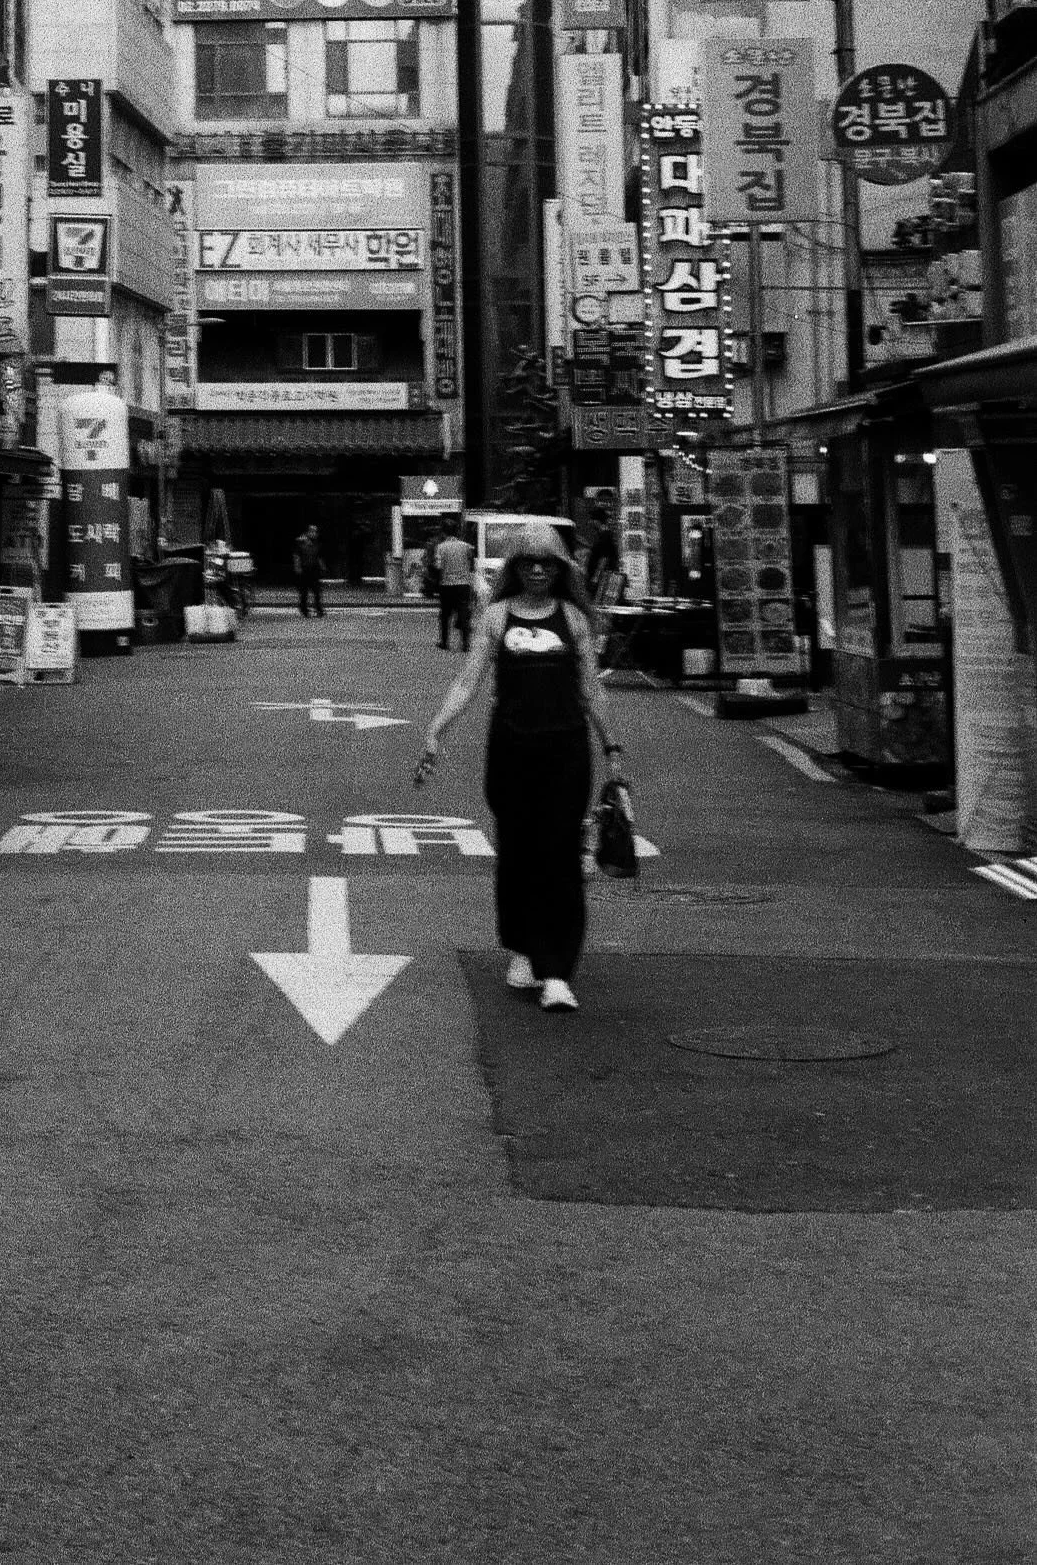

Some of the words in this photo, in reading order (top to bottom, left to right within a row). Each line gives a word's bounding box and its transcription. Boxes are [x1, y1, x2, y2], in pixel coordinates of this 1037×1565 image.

[857, 75, 918, 99] 소문난
[60, 99, 90, 178] 미용실
[837, 99, 948, 142] 경북집
[733, 72, 791, 213] 경북집
[199, 231, 242, 269] EZ
[304, 232, 359, 258] 세무사
[67, 522, 122, 545] 도시락
